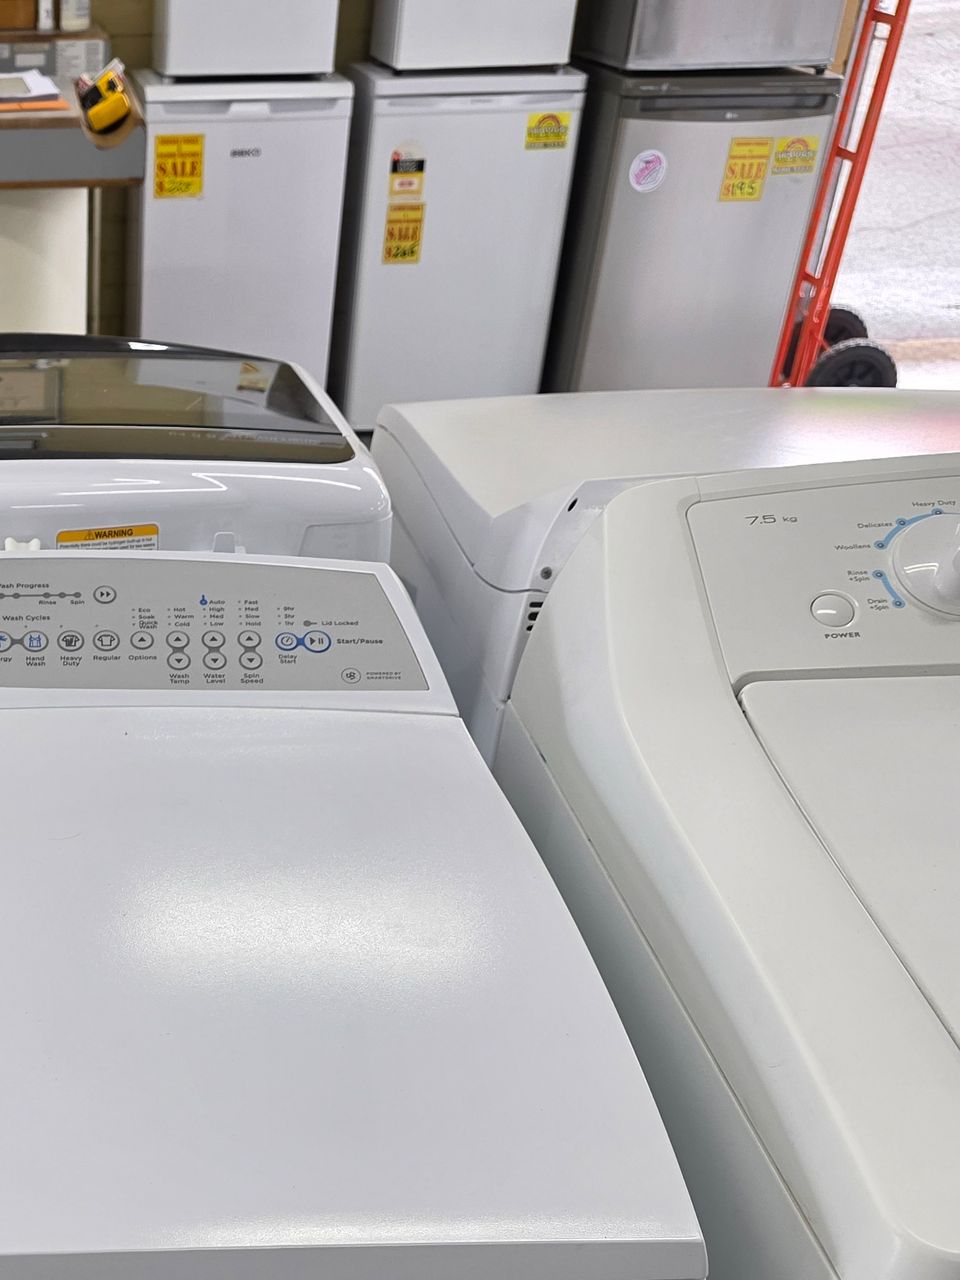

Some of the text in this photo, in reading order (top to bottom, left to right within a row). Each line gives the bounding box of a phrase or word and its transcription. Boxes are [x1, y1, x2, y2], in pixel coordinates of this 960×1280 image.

[157, 161, 198, 177] SALE
[745, 514, 776, 525] 7.5
[94, 528, 133, 540] WARNING
[824, 632, 861, 640] POWER
